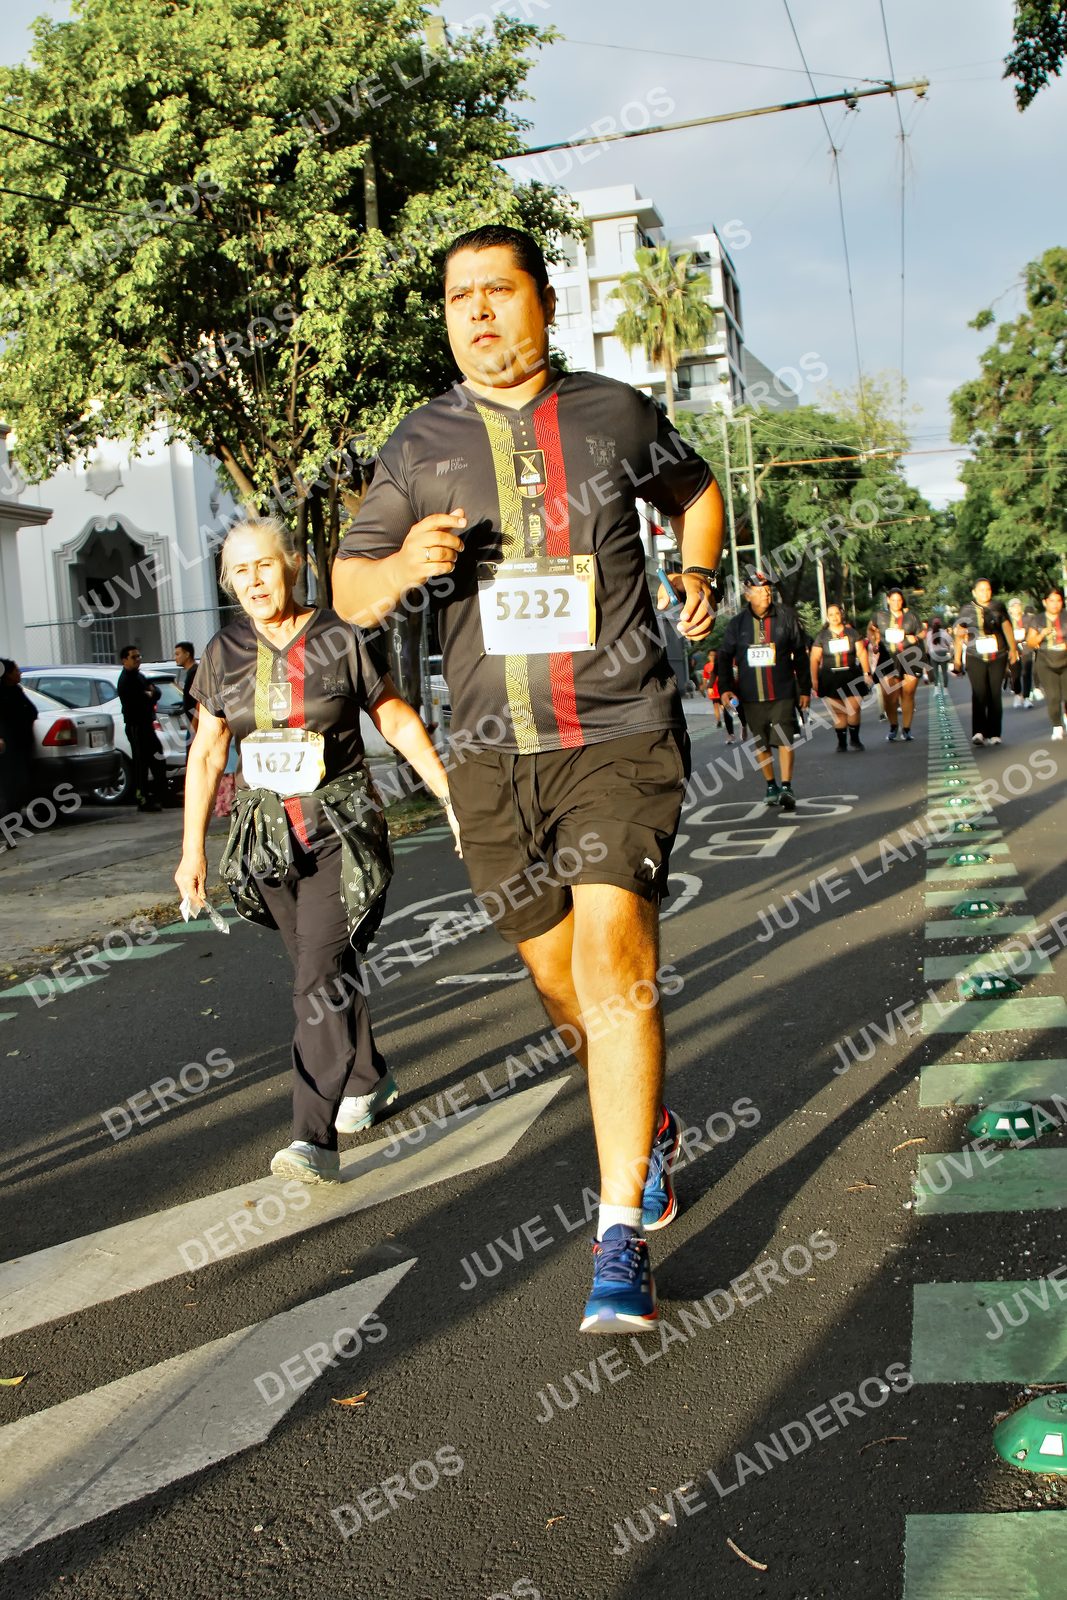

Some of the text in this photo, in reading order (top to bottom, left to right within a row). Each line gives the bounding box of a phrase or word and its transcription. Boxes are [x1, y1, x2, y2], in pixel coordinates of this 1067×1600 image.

[576, 563, 590, 573] 5K
[496, 588, 571, 621] 5232
[751, 650, 770, 659] 3271
[252, 751, 305, 773] 1627
